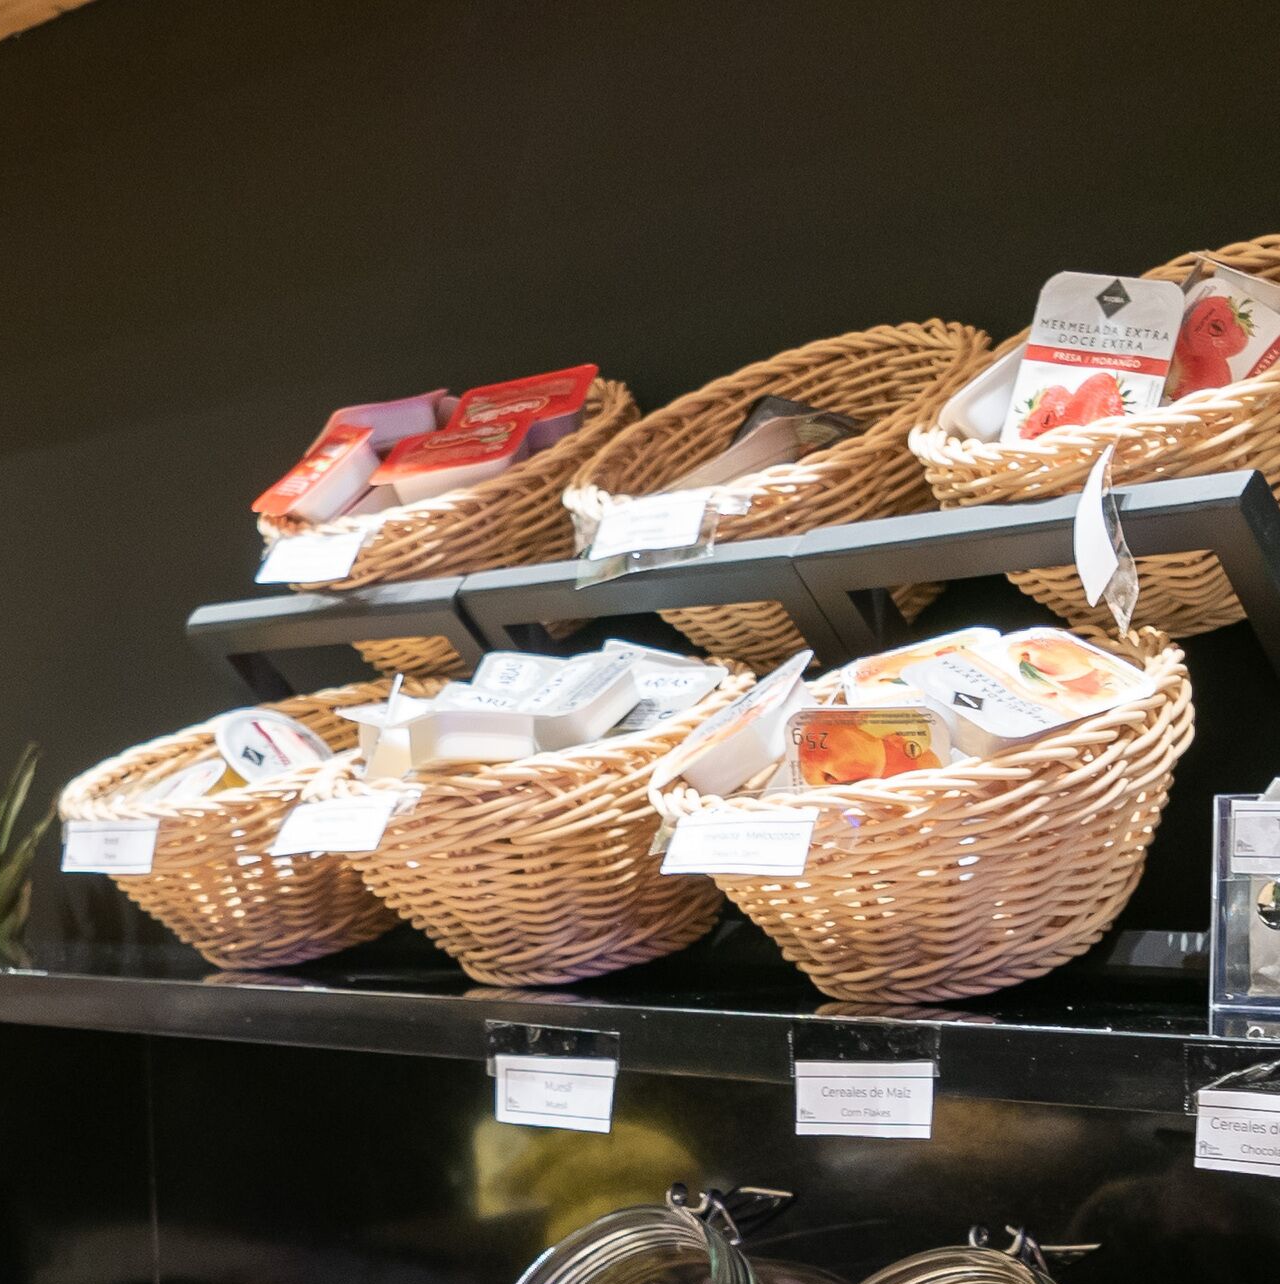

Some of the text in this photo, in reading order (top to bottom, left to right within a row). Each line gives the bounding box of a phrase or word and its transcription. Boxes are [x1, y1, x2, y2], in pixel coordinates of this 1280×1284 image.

[1040, 318, 1170, 342] MERMELADA EXTRA
[1058, 333, 1144, 351] DOCE EXTRA
[1052, 351, 1082, 363] FRESA
[1091, 356, 1142, 369] MORANGO
[821, 1086, 867, 1099] Cereales
[870, 1087, 884, 1098] de
[863, 1107, 891, 1118] Flakes
[1210, 1117, 1267, 1135] Cereales
